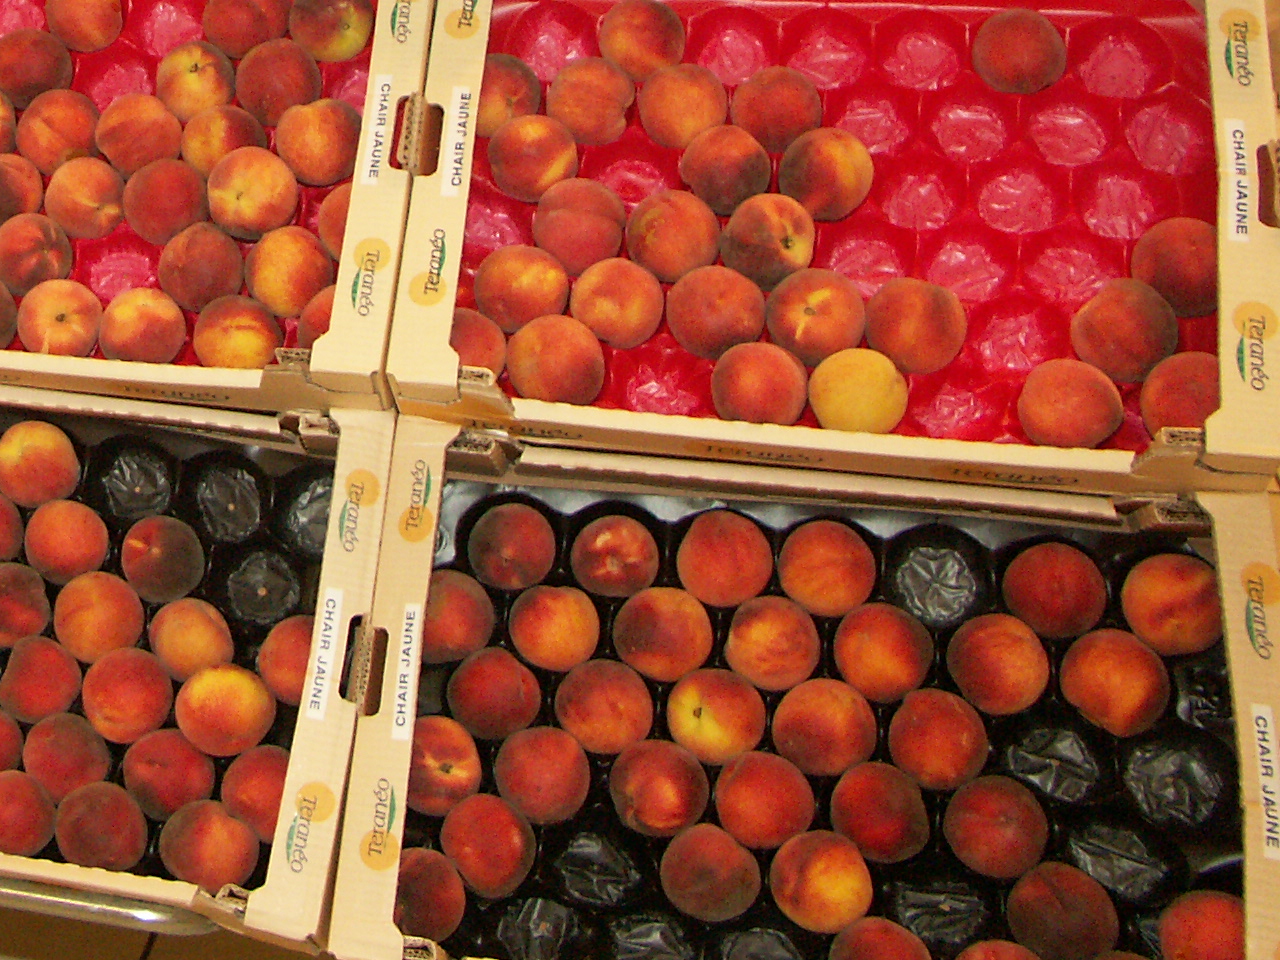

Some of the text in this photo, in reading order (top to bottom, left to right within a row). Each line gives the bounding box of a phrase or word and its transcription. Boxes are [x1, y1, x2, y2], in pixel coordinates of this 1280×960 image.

[368, 82, 391, 178] CHAIR JAUNE
[450, 92, 472, 187] CHAIR JAUNE
[1232, 129, 1248, 235] CHAIR JAUNE
[309, 597, 336, 711] CHAIR JAUNE
[395, 609, 416, 728] CHAIR JAUNE
[1254, 715, 1273, 776] CHAIR
